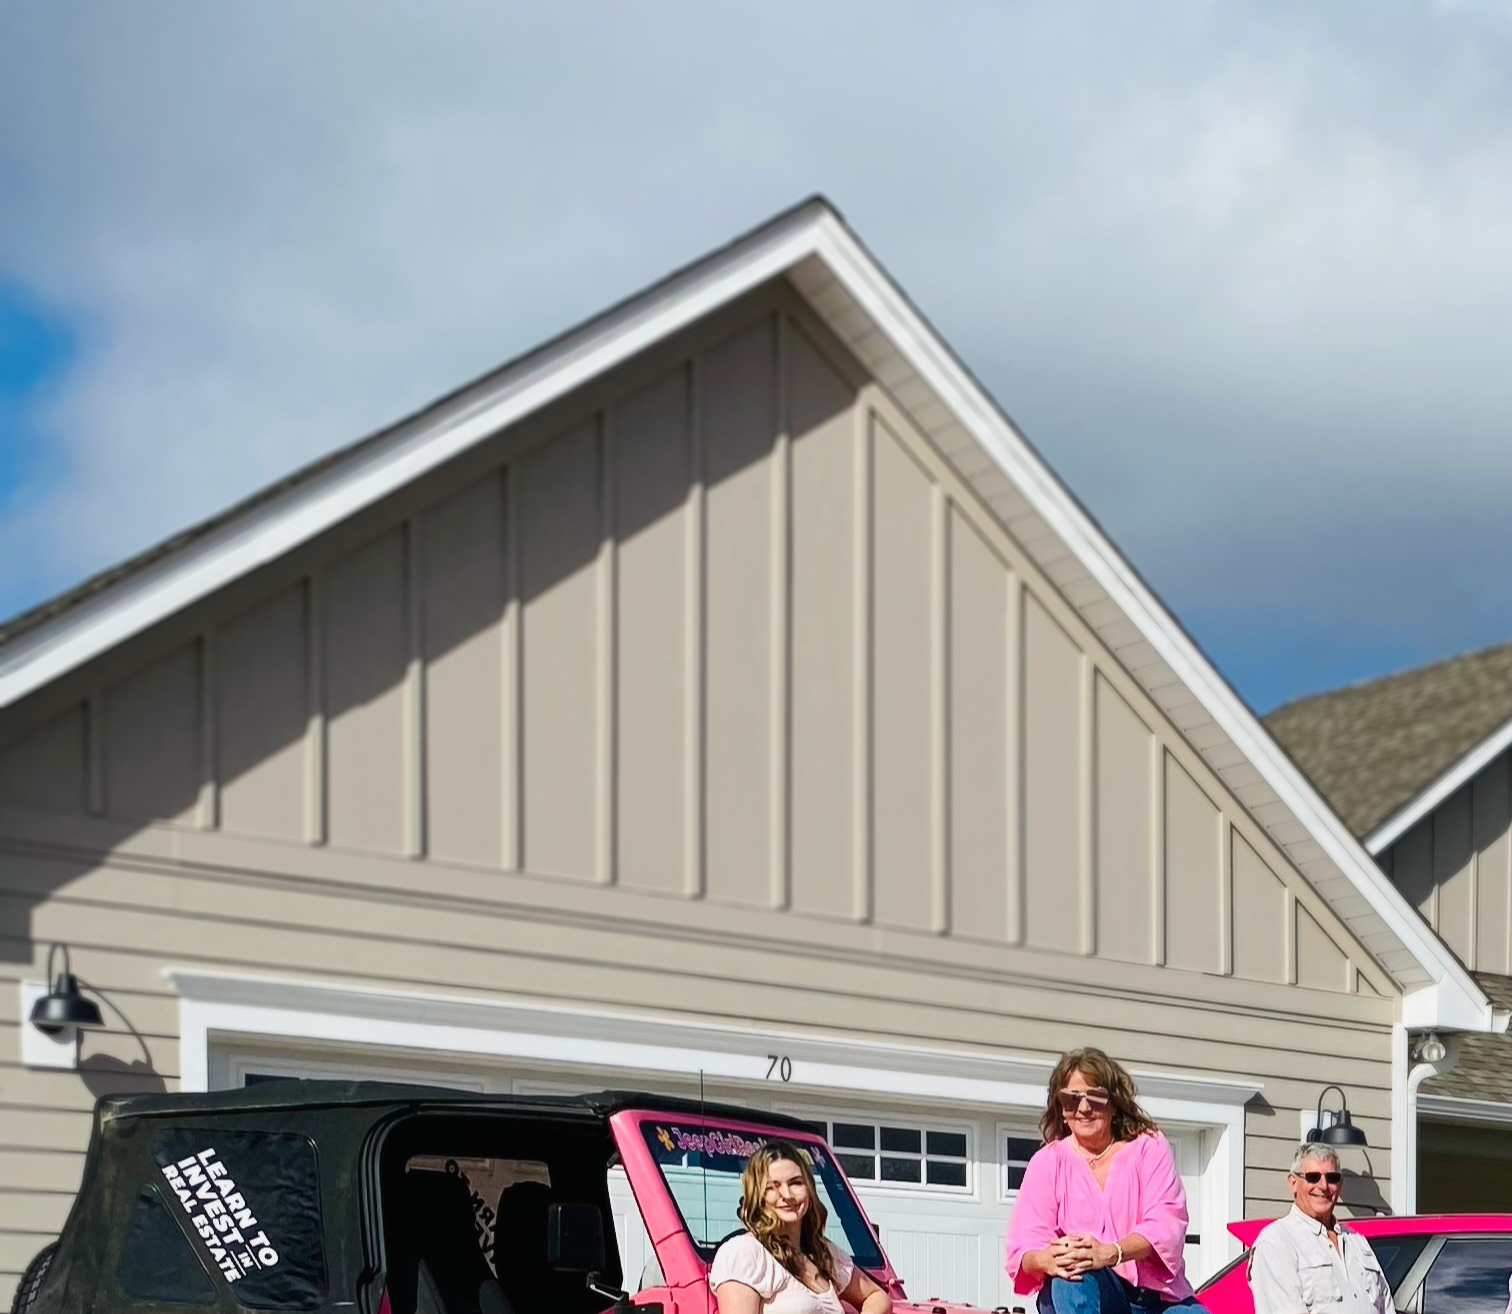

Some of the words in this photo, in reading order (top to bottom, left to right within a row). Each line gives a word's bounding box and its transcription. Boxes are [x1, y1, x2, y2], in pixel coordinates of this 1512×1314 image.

[765, 1054, 792, 1083] 70
[161, 1164, 198, 1214] REAL
[191, 1213, 242, 1283] ESTATE
[177, 1156, 245, 1245] INVEST
[238, 1252, 254, 1269] IN
[197, 1148, 258, 1230] LEARN
[249, 1230, 279, 1267] TO
